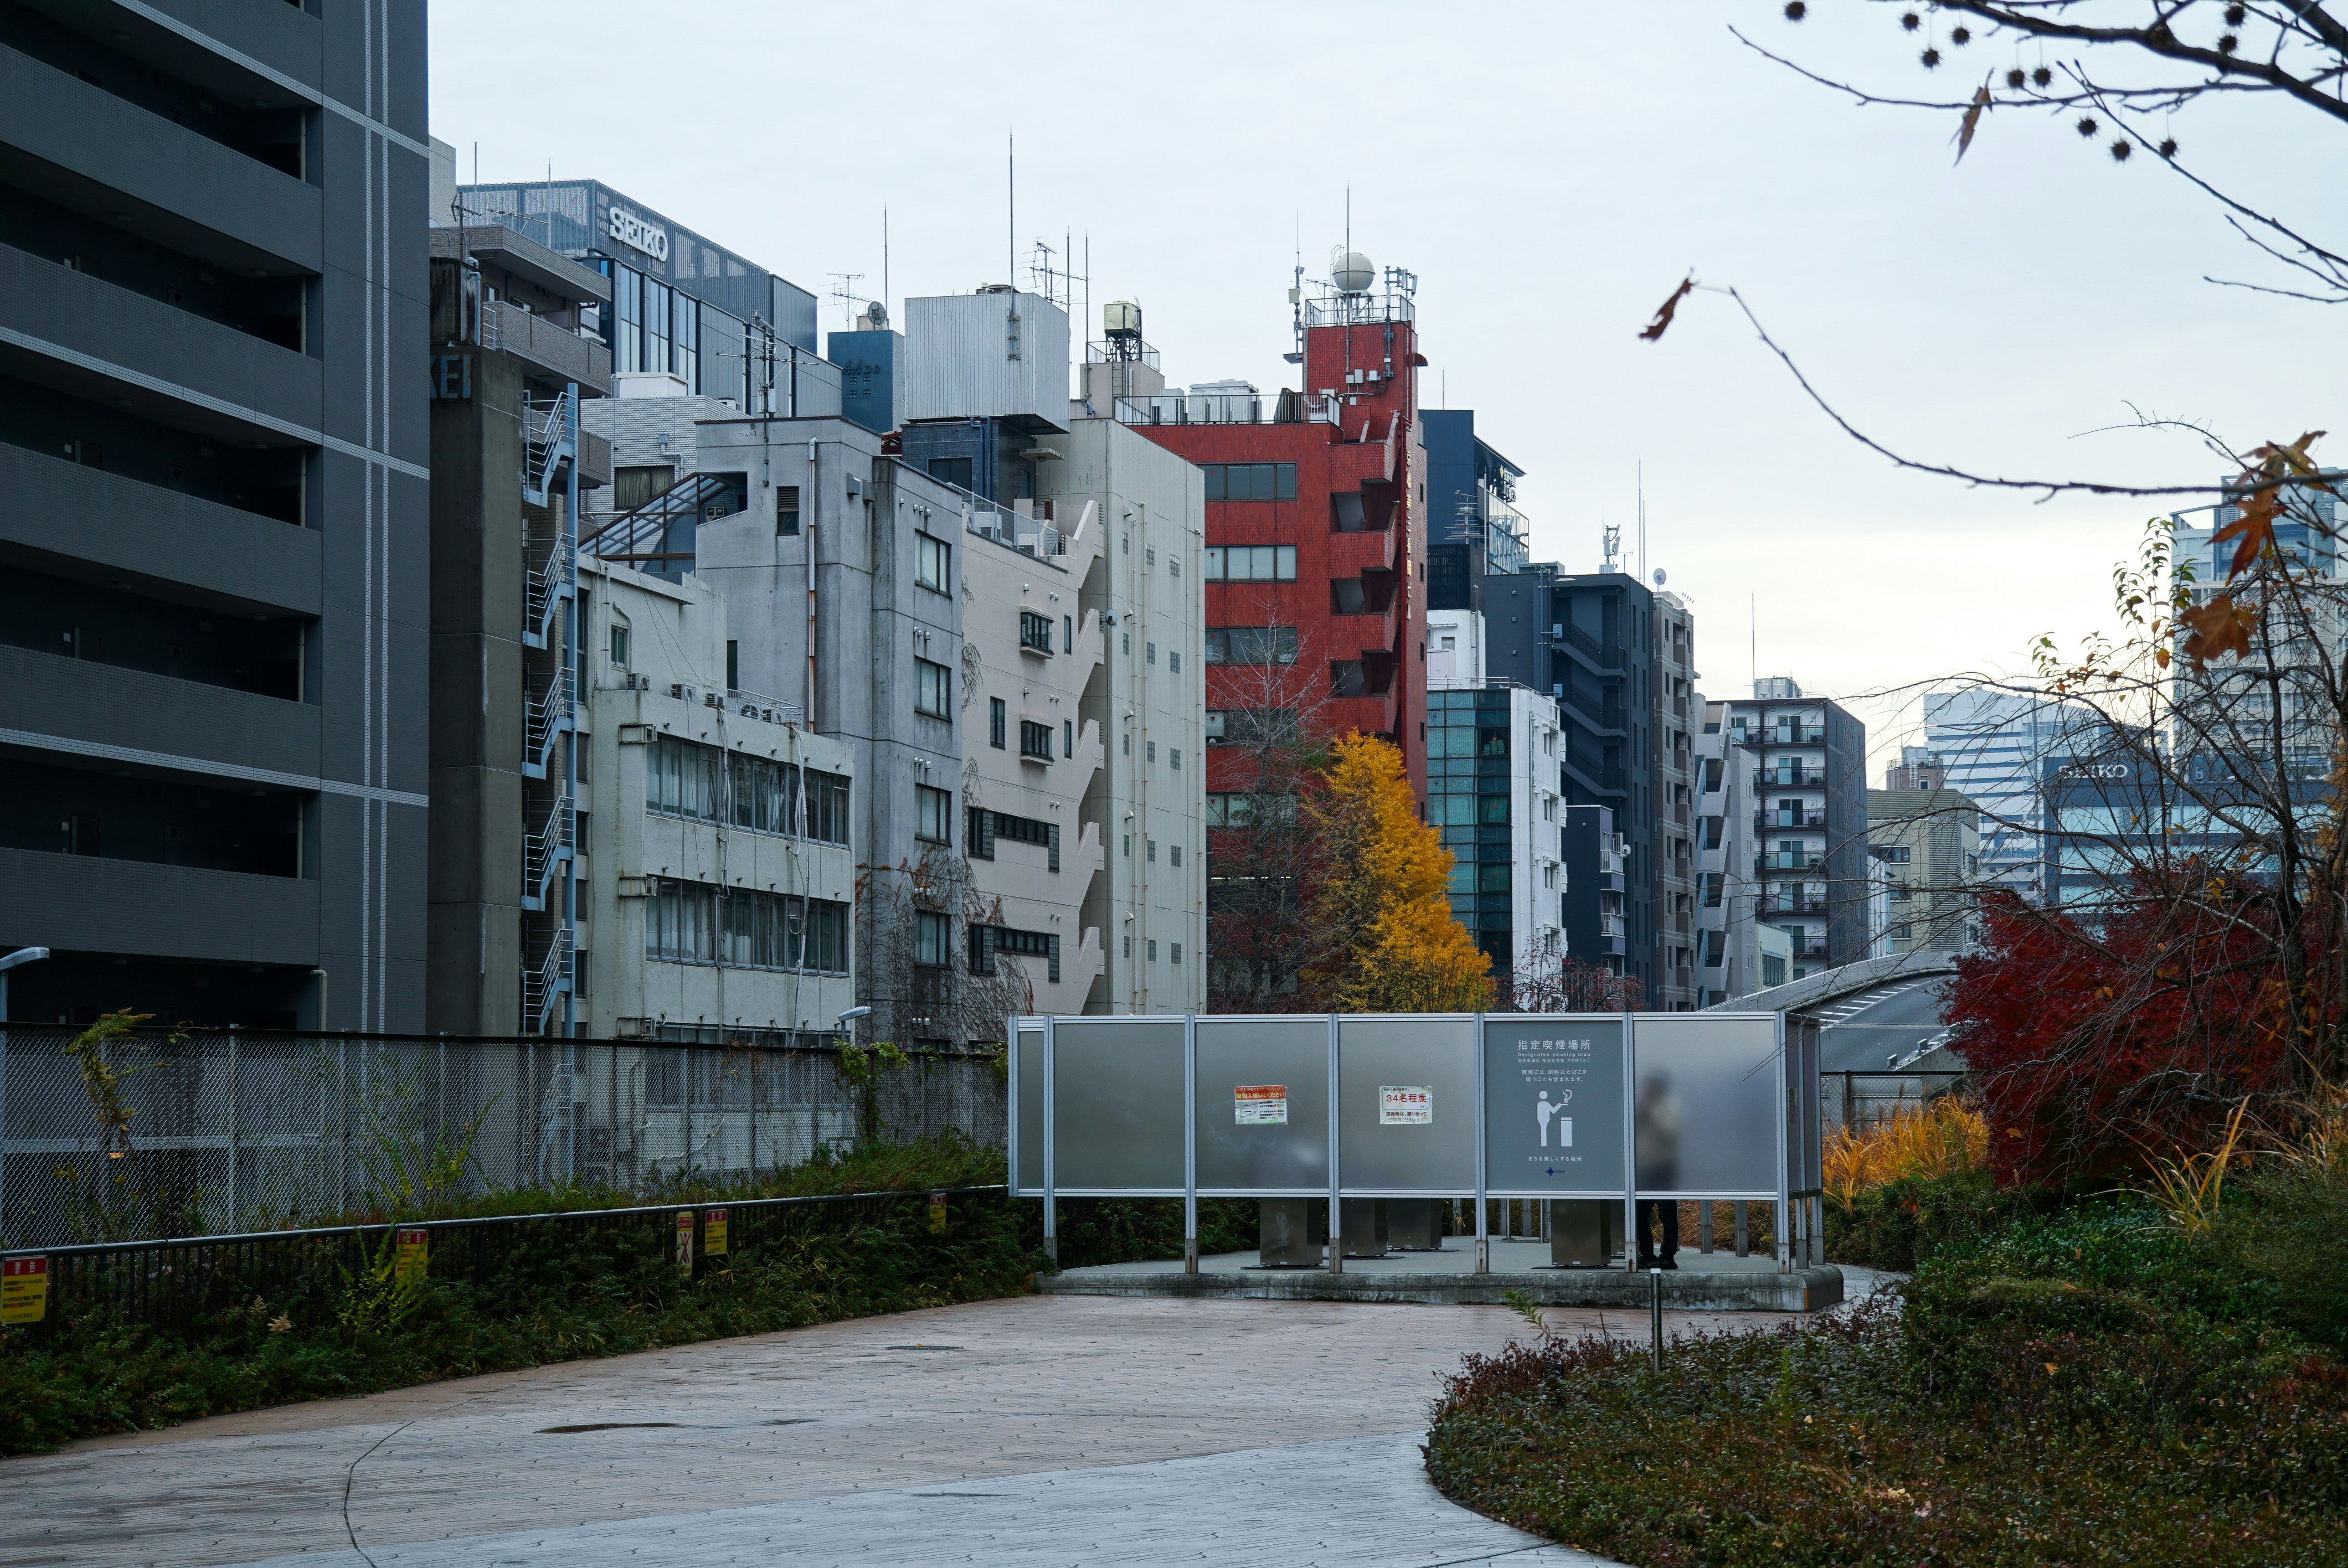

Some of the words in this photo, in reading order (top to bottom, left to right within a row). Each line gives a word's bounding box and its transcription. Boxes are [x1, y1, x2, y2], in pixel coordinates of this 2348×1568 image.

[610, 207, 668, 262] SEIKO
[430, 354, 471, 399] EI
[1517, 1040, 1590, 1050] 指定喫煙場所
[1386, 1094, 1427, 1102] 34名程度
[14, 1261, 36, 1275] 警告
